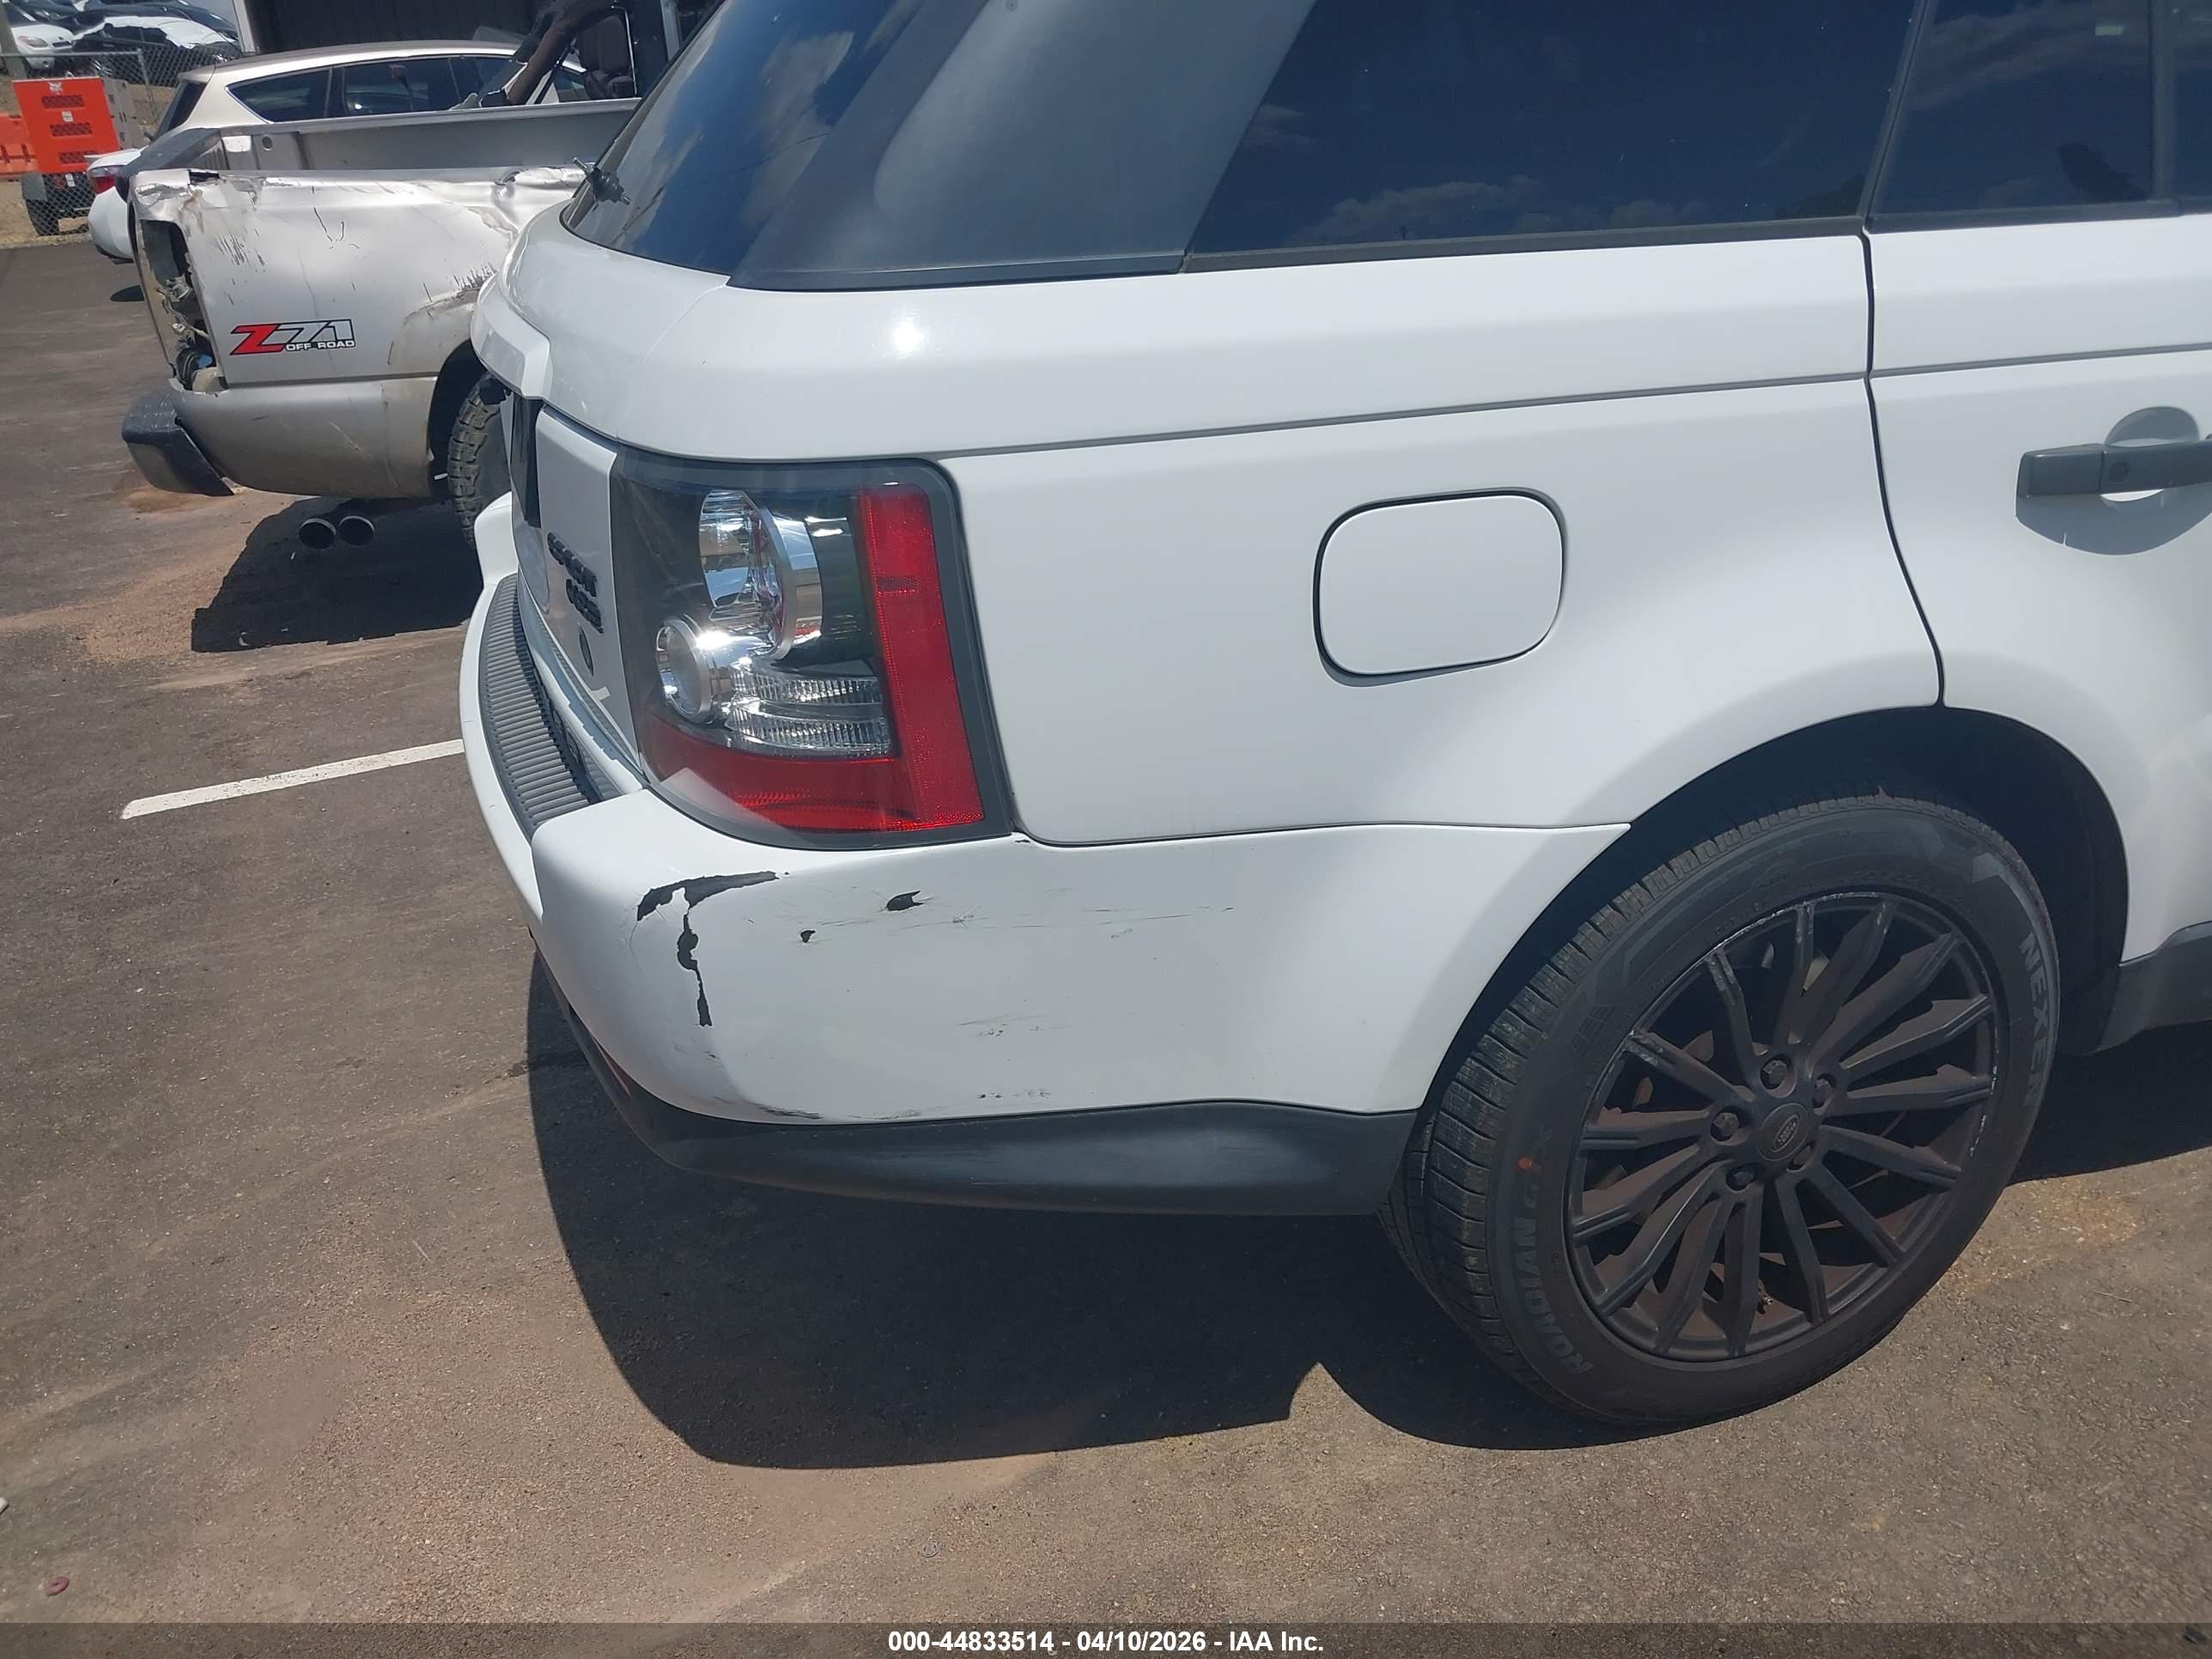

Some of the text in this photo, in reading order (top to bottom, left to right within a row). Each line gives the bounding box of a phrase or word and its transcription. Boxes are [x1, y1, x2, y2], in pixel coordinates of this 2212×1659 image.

[229, 319, 355, 356] Z71
[286, 341, 356, 352] OFF ROAD
[2019, 932, 2049, 1105] NEXEN
[1514, 1217, 1595, 1376] ROADIAN
